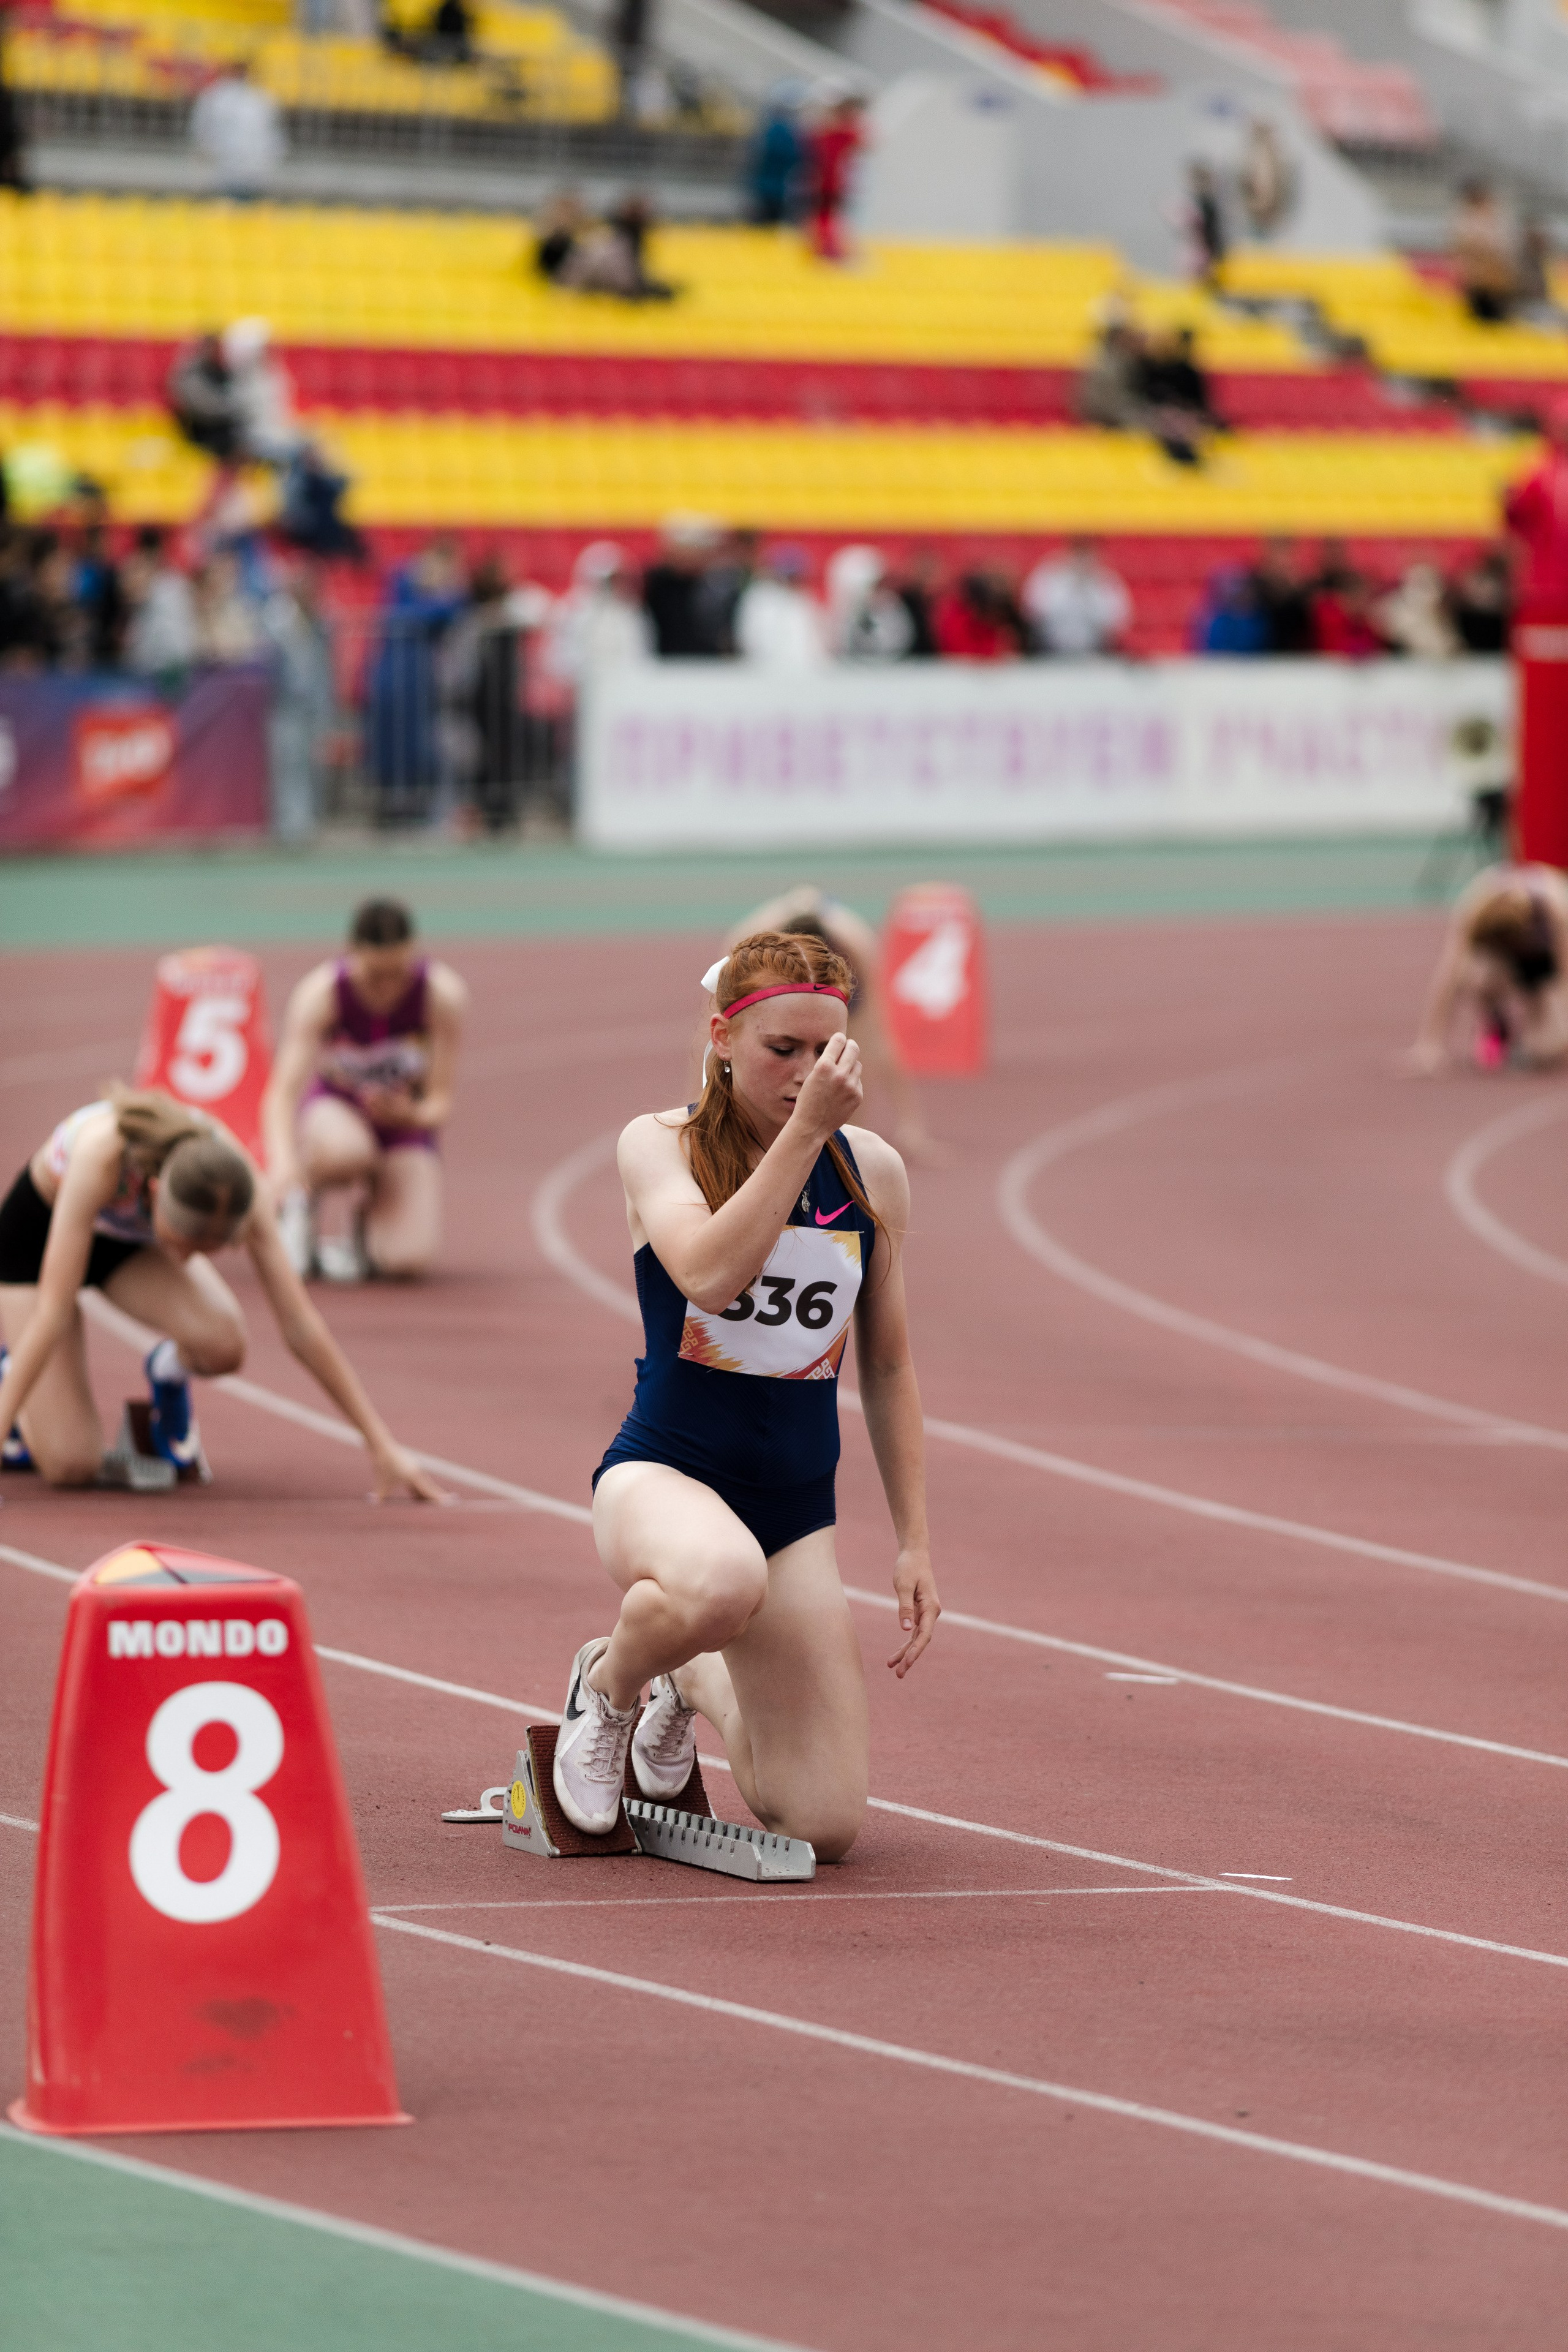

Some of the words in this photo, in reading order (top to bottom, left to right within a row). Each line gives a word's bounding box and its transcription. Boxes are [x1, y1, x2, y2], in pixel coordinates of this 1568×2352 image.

[892, 922, 968, 1019] 4
[168, 998, 250, 1101] 5
[108, 1619, 288, 1659] MONDO
[130, 1681, 284, 1924] 8
